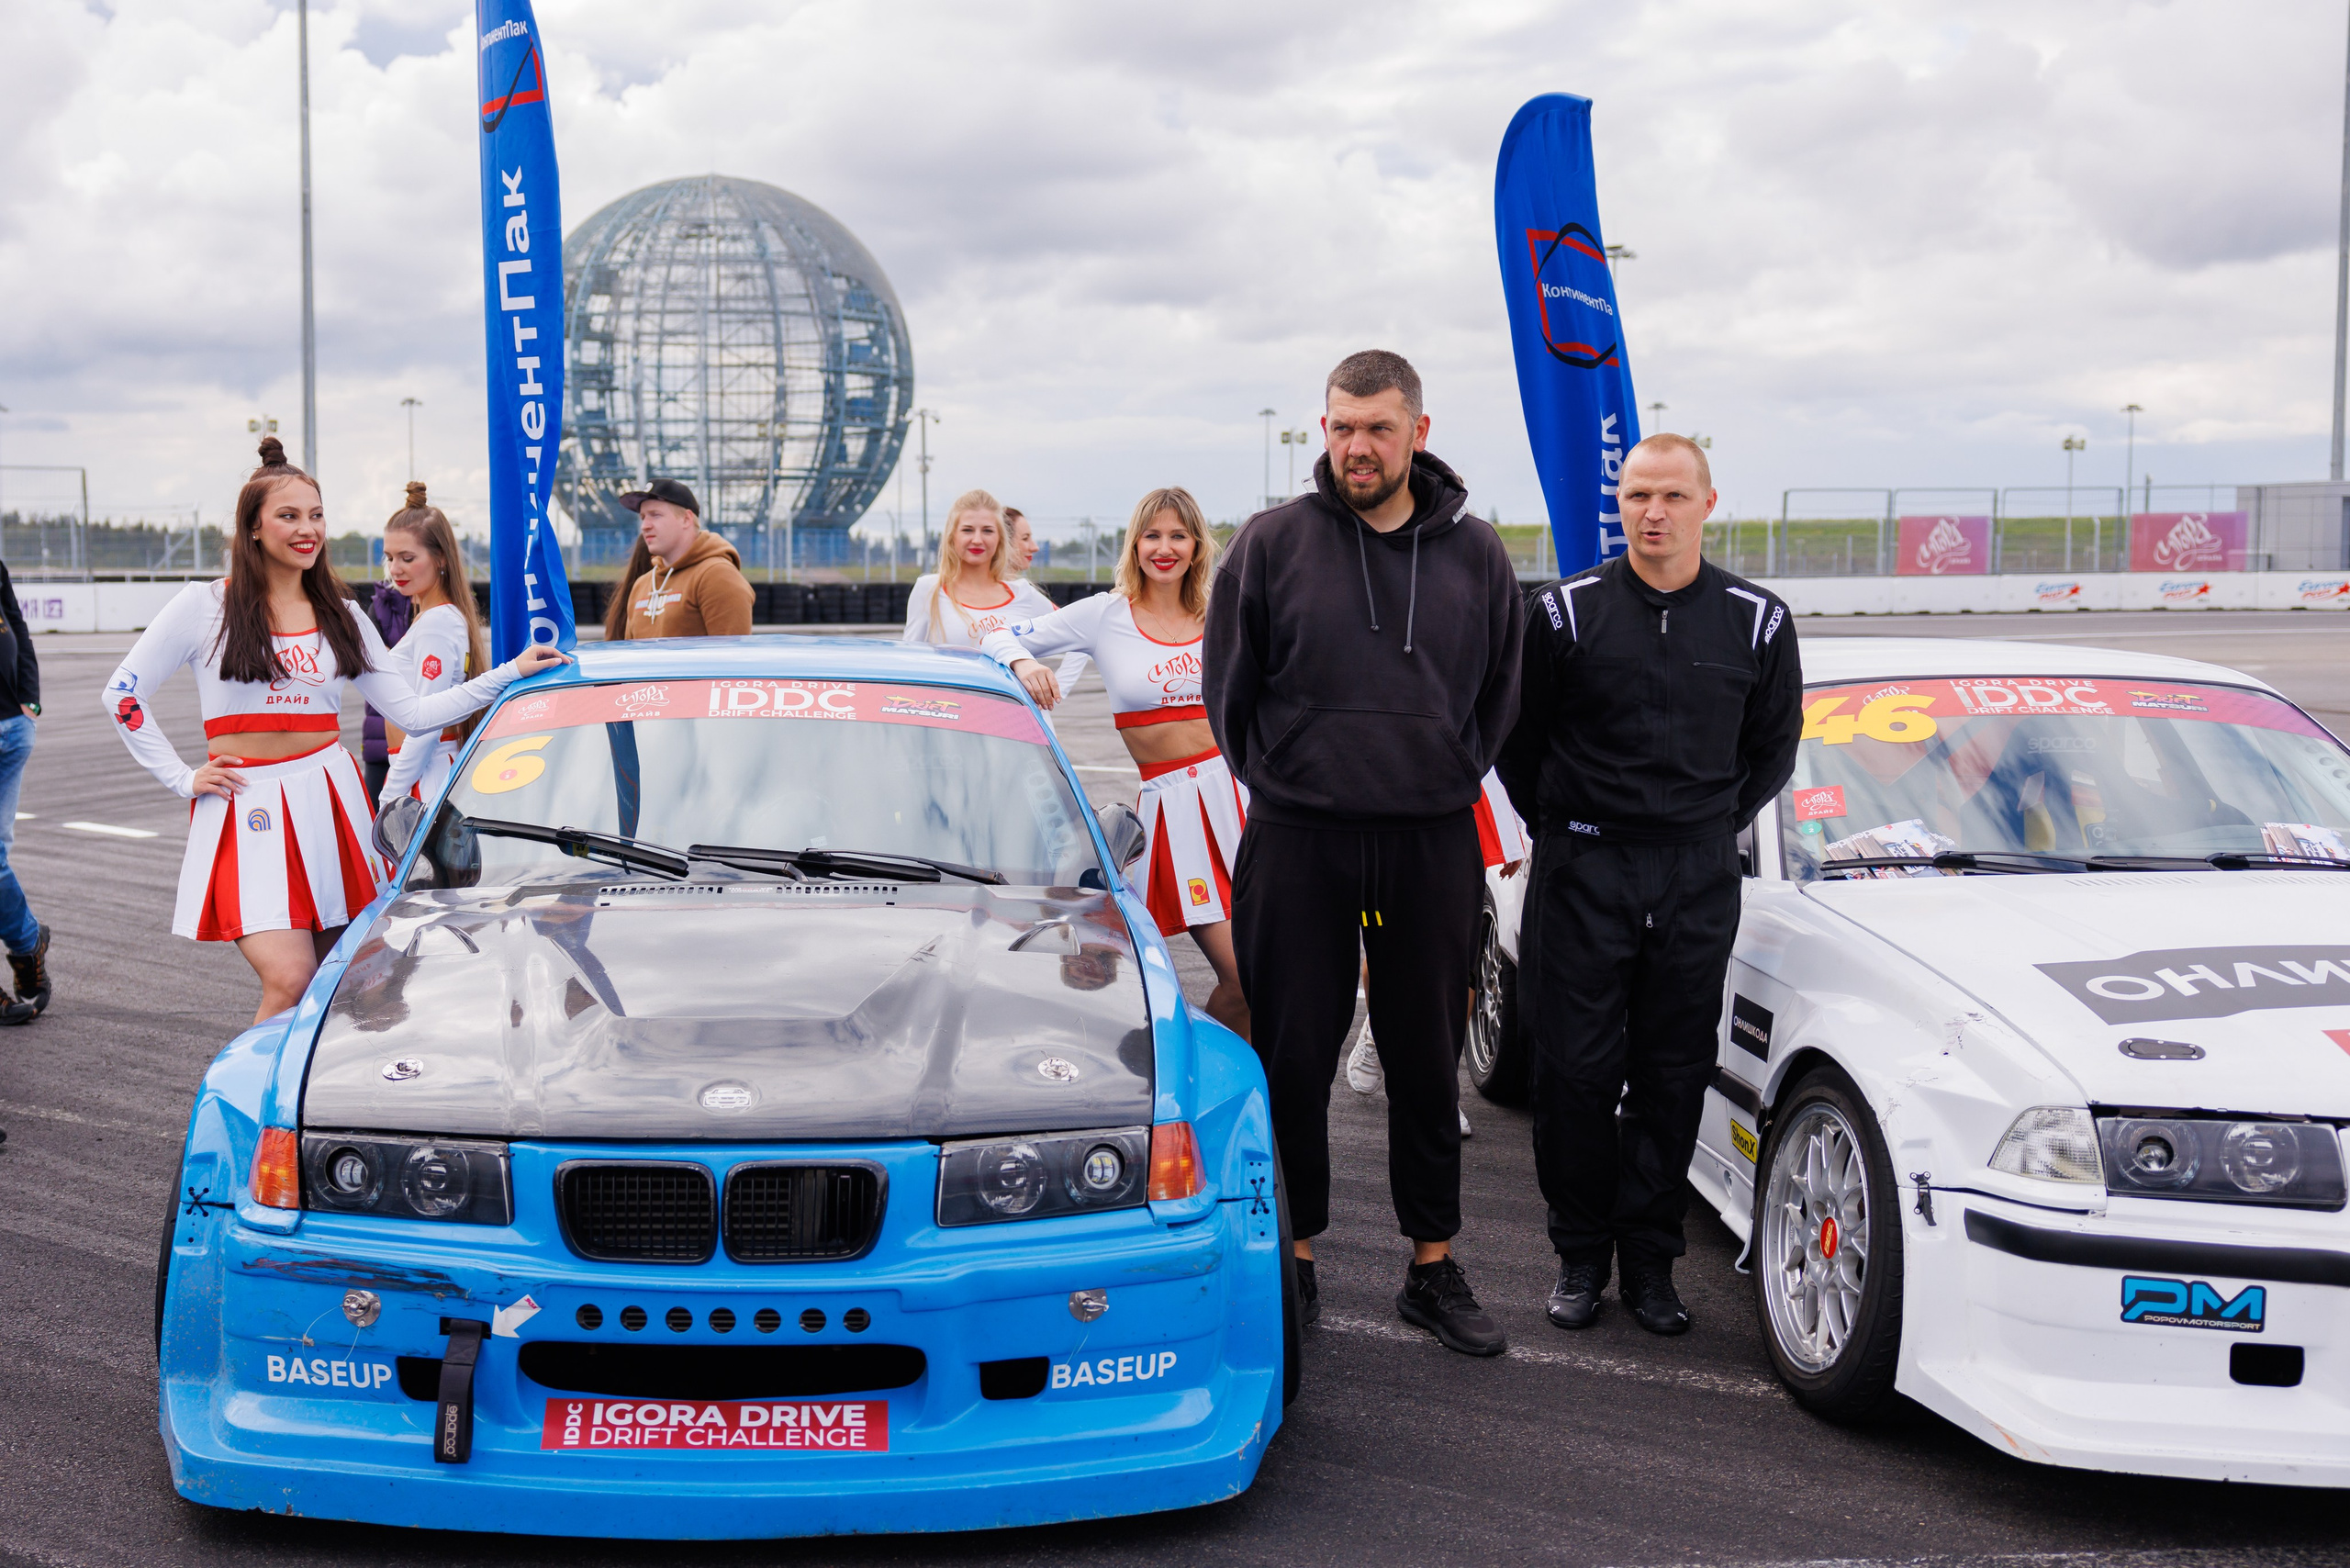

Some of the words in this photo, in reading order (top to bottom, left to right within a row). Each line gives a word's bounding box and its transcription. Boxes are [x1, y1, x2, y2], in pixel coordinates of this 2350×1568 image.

[1542, 283, 1613, 316] КонтинентПа
[711, 680, 778, 689] IGORA
[791, 681, 856, 690] DRIVE
[1953, 686, 2108, 707] IDDC
[266, 693, 309, 704] ДРАЙВ
[709, 688, 856, 712] IDDC
[1161, 693, 1202, 704] ДРАЙВ
[2018, 706, 2115, 714] CHALLENGE
[621, 711, 661, 719] ДРАЙВ
[708, 709, 756, 718] DRIFT
[760, 710, 856, 720] CHALLENGE
[881, 706, 960, 720] MATSURI
[1799, 694, 1938, 745] 46
[471, 735, 554, 795] 6
[1568, 821, 1600, 835] sparc
[2086, 960, 2350, 1001] ОНЛИ
[1733, 1015, 1768, 1044] ОНЛИШКОДА
[1731, 1124, 1755, 1158] ShonX
[2123, 1278, 2264, 1320] PM
[2143, 1314, 2262, 1331] POPOVMOTORSPORT
[267, 1355, 392, 1389] BASEUP
[1050, 1350, 1177, 1390] BASEUP
[563, 1403, 583, 1445] IDDC
[592, 1403, 727, 1426] IGORA
[739, 1405, 867, 1427] DRIVE
[589, 1427, 678, 1446] DRIFT
[685, 1428, 867, 1447] CHALLENGE
